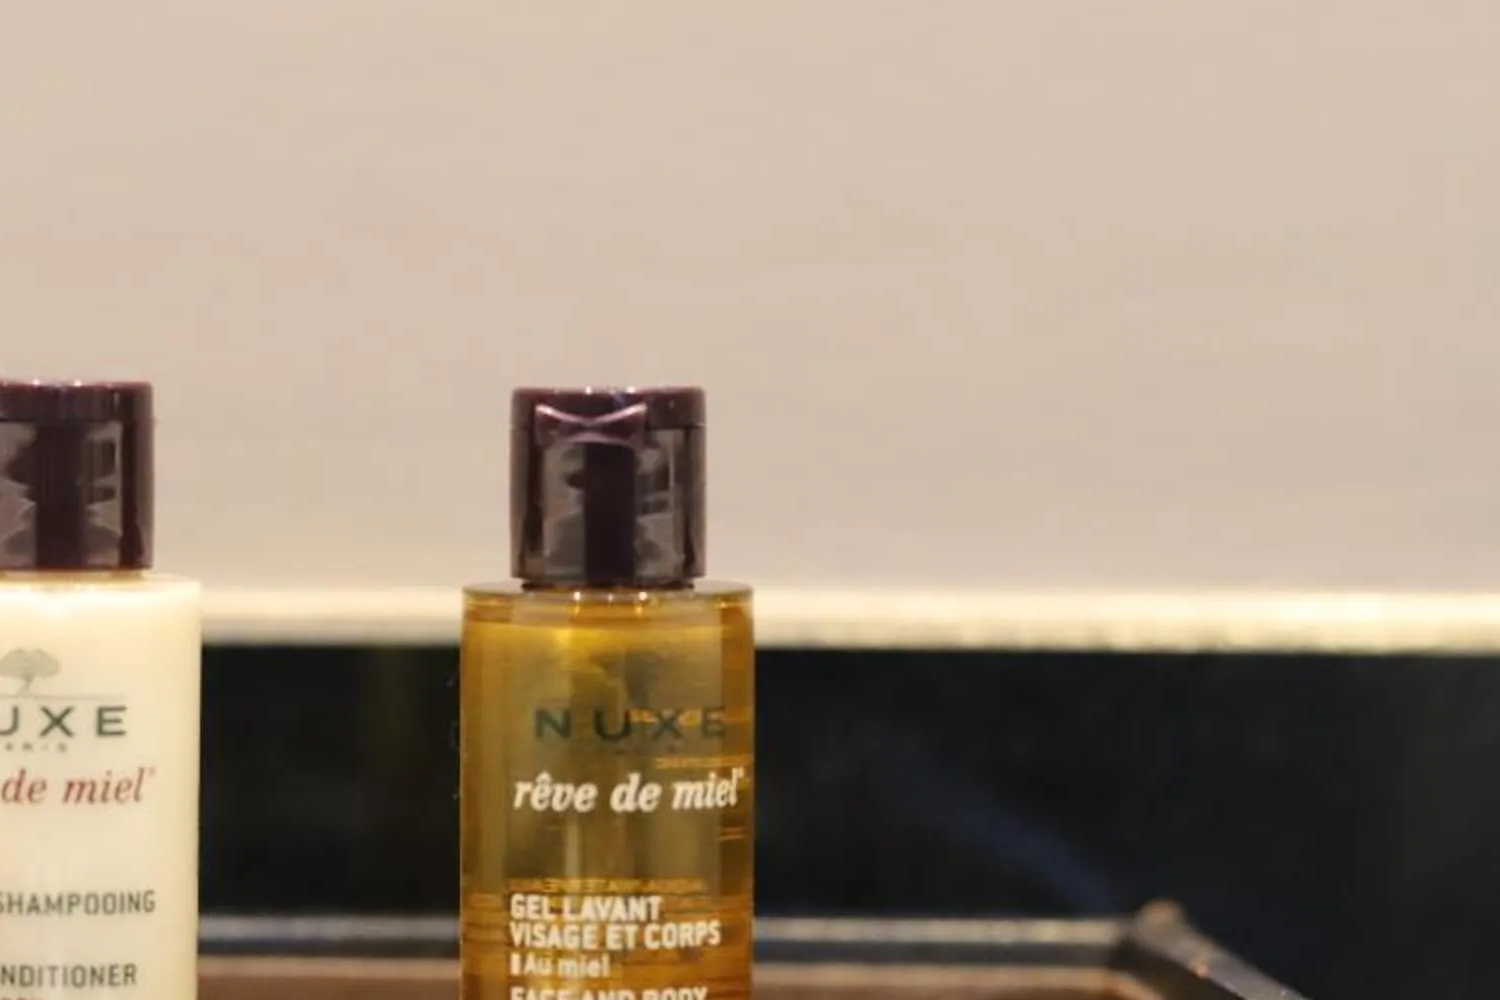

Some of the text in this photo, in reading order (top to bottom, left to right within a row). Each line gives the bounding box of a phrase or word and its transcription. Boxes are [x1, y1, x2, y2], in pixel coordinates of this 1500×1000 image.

[535, 707, 726, 741] NUXE
[1, 768, 47, 803] de
[62, 766, 146, 804] miel
[513, 768, 740, 812] rêve de miel
[510, 893, 662, 921] GEL LAVANT
[510, 920, 721, 949] VISAGE ET CORPS
[524, 953, 610, 978] Au miel
